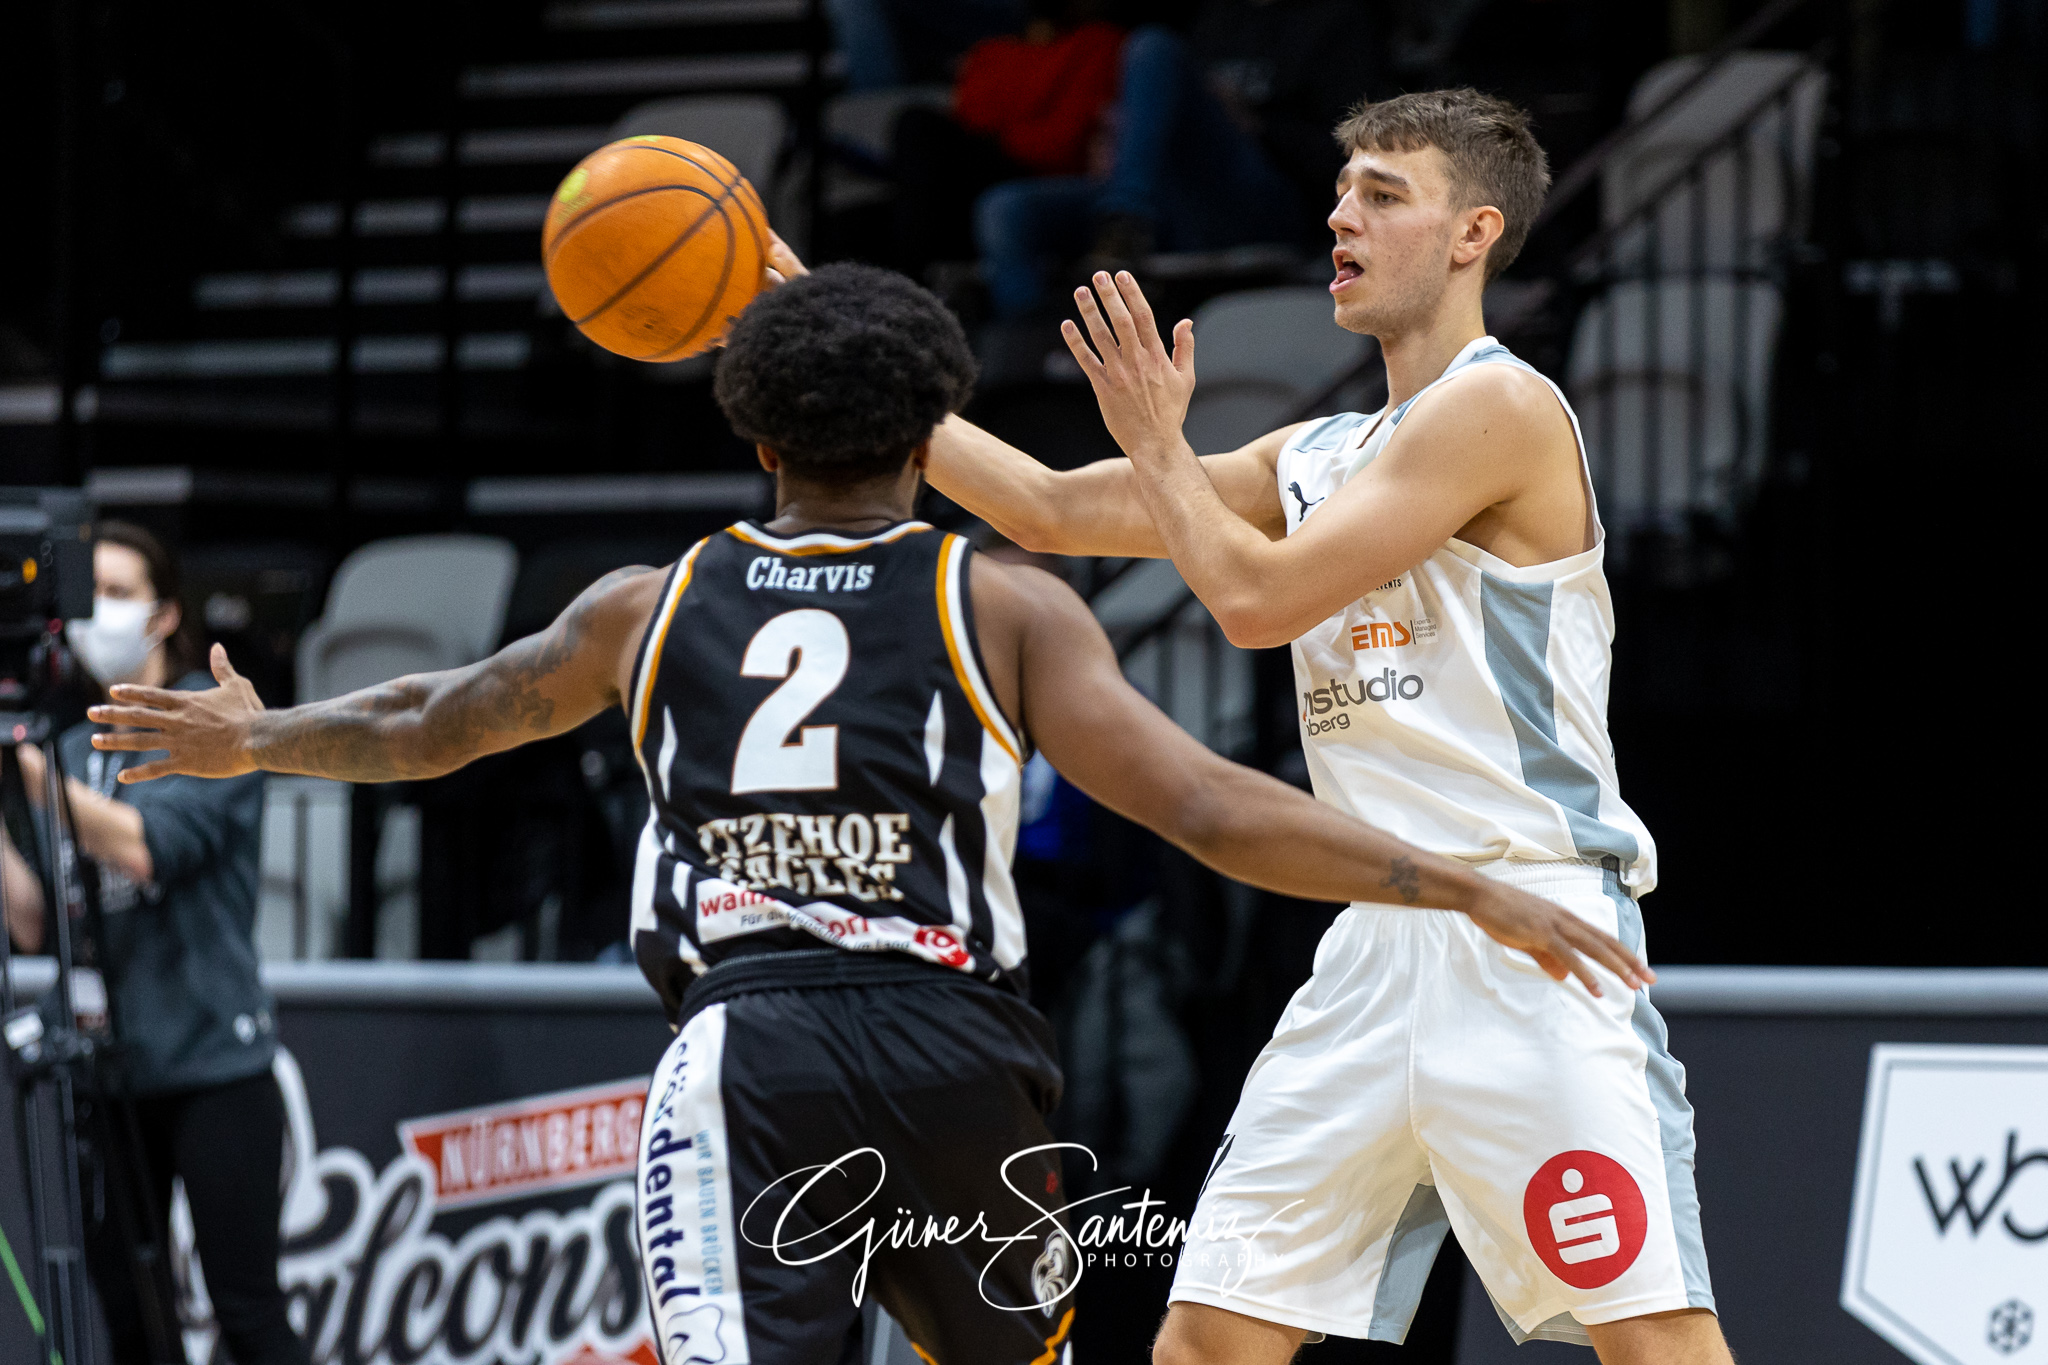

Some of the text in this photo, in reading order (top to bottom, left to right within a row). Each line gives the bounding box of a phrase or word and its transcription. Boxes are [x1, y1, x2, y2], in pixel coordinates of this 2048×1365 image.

[746, 556, 875, 592] Charvis
[1351, 621, 1411, 651] EMS
[731, 608, 850, 795] 2
[698, 813, 912, 864] ITZEHOE
[440, 1100, 643, 1192] NÜRNBERG
